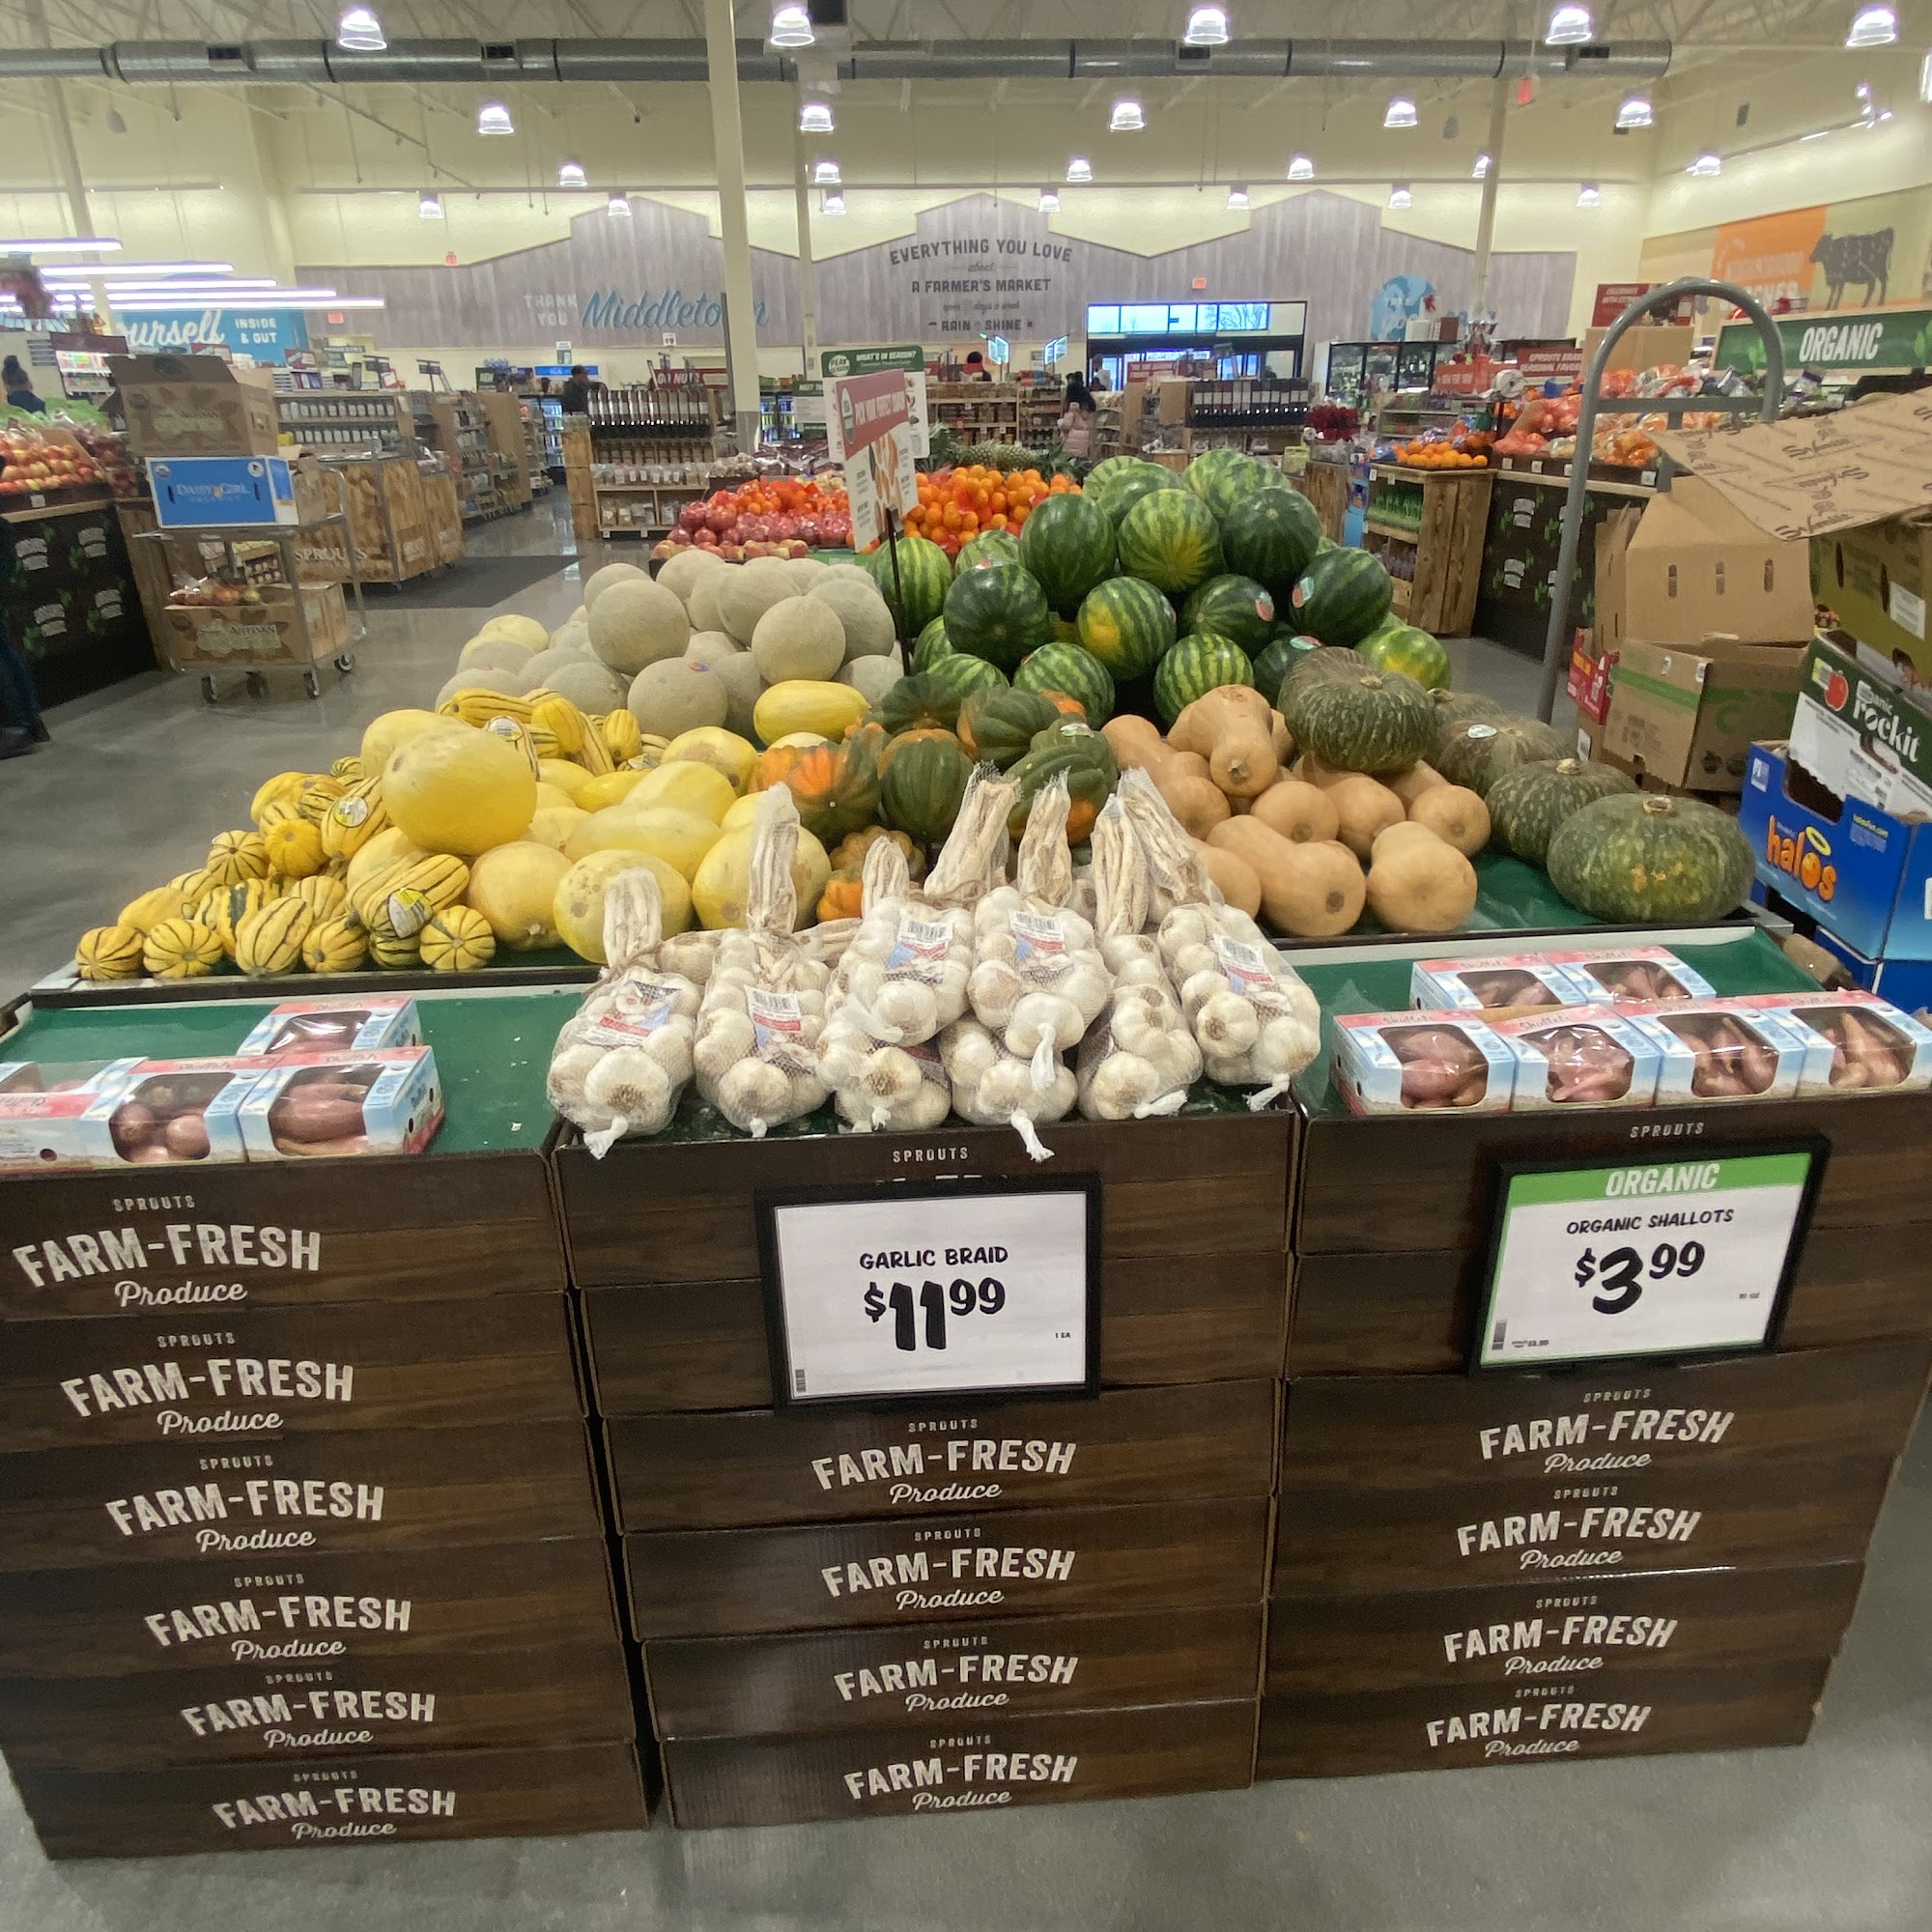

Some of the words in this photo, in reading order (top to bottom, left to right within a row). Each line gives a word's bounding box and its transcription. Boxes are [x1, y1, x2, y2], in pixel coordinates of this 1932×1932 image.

[890, 239, 989, 265] EVERYTHING
[996, 239, 1027, 255] YOU
[1033, 242, 1072, 263] LOVE
[912, 281, 920, 293] A
[925, 279, 991, 293] FARMER'S
[996, 278, 1051, 291] MARKET
[523, 294, 578, 309] THANK
[582, 290, 770, 329] Middleton
[117, 309, 226, 347] ourself
[235, 318, 277, 329] INSIDE
[537, 313, 568, 327] YOU
[942, 320, 971, 331] RAIN
[984, 319, 1021, 331] SHINE
[252, 332, 277, 344] OUT
[1800, 323, 1884, 362] ORGANIC
[295, 548, 367, 561] SPROUS
[1853, 699, 1921, 762] rockit
[1767, 814, 1837, 903] halos
[1630, 1122, 1704, 1138] SPROUTS
[893, 1147, 969, 1163] SPROUTS
[1605, 1163, 1720, 1197] ORGANIC
[113, 1195, 195, 1211] SPROUTS
[1566, 1216, 1641, 1235] ORGANIC
[1648, 1208, 1734, 1229] SHALLOTS
[13, 1224, 321, 1288] FARM-FRESH
[860, 1250, 936, 1269] GARLIC
[945, 1246, 1009, 1265] BRAID
[114, 1280, 247, 1307] Produce
[157, 1332, 236, 1348] SPROUTS
[61, 1359, 354, 1417] FARM-FRESH
[1583, 1388, 1651, 1403] SPROUTS
[157, 1410, 283, 1435] Produce
[908, 1419, 979, 1433] SPROUTS
[1480, 1409, 1735, 1460] FARM-FRESH
[199, 1455, 273, 1470] SPROUTS
[811, 1439, 1076, 1491] FARM-FRESH
[1544, 1453, 1652, 1473] Produce
[890, 1483, 1003, 1504] Produce
[1553, 1487, 1618, 1499] SPROUTS
[106, 1480, 384, 1536] FARM-FRESH
[196, 1528, 316, 1552] Produce
[915, 1528, 980, 1542] SPROUTS
[1457, 1507, 1702, 1556] FARM-FRESH
[1520, 1549, 1623, 1570] Produce
[234, 1574, 304, 1587] SPROUTS
[821, 1548, 1075, 1597] FARM-FRESH
[895, 1589, 1005, 1610] Produce
[1536, 1596, 1598, 1608] SPROUTS
[145, 1596, 412, 1647] FARM-FRESH
[924, 1636, 987, 1649] SPROUTS
[1444, 1615, 1678, 1662] FARM-FRESH
[231, 1639, 347, 1662] Produce
[1504, 1656, 1604, 1676] Produce
[834, 1655, 1078, 1701] FARM-FRESH
[905, 1692, 1009, 1712] Produce
[181, 1690, 435, 1736] FARM-FRESH
[1426, 1703, 1652, 1747] FARM-FRESH
[264, 1729, 374, 1748] Produce
[930, 1735, 991, 1748] SPROUTS
[1485, 1739, 1579, 1757] Produce
[843, 1753, 1078, 1799] FARM-FRESH
[213, 1788, 455, 1829] FARM-FRESH
[912, 1791, 1012, 1810] Produce
[292, 1822, 397, 1839] Produce
